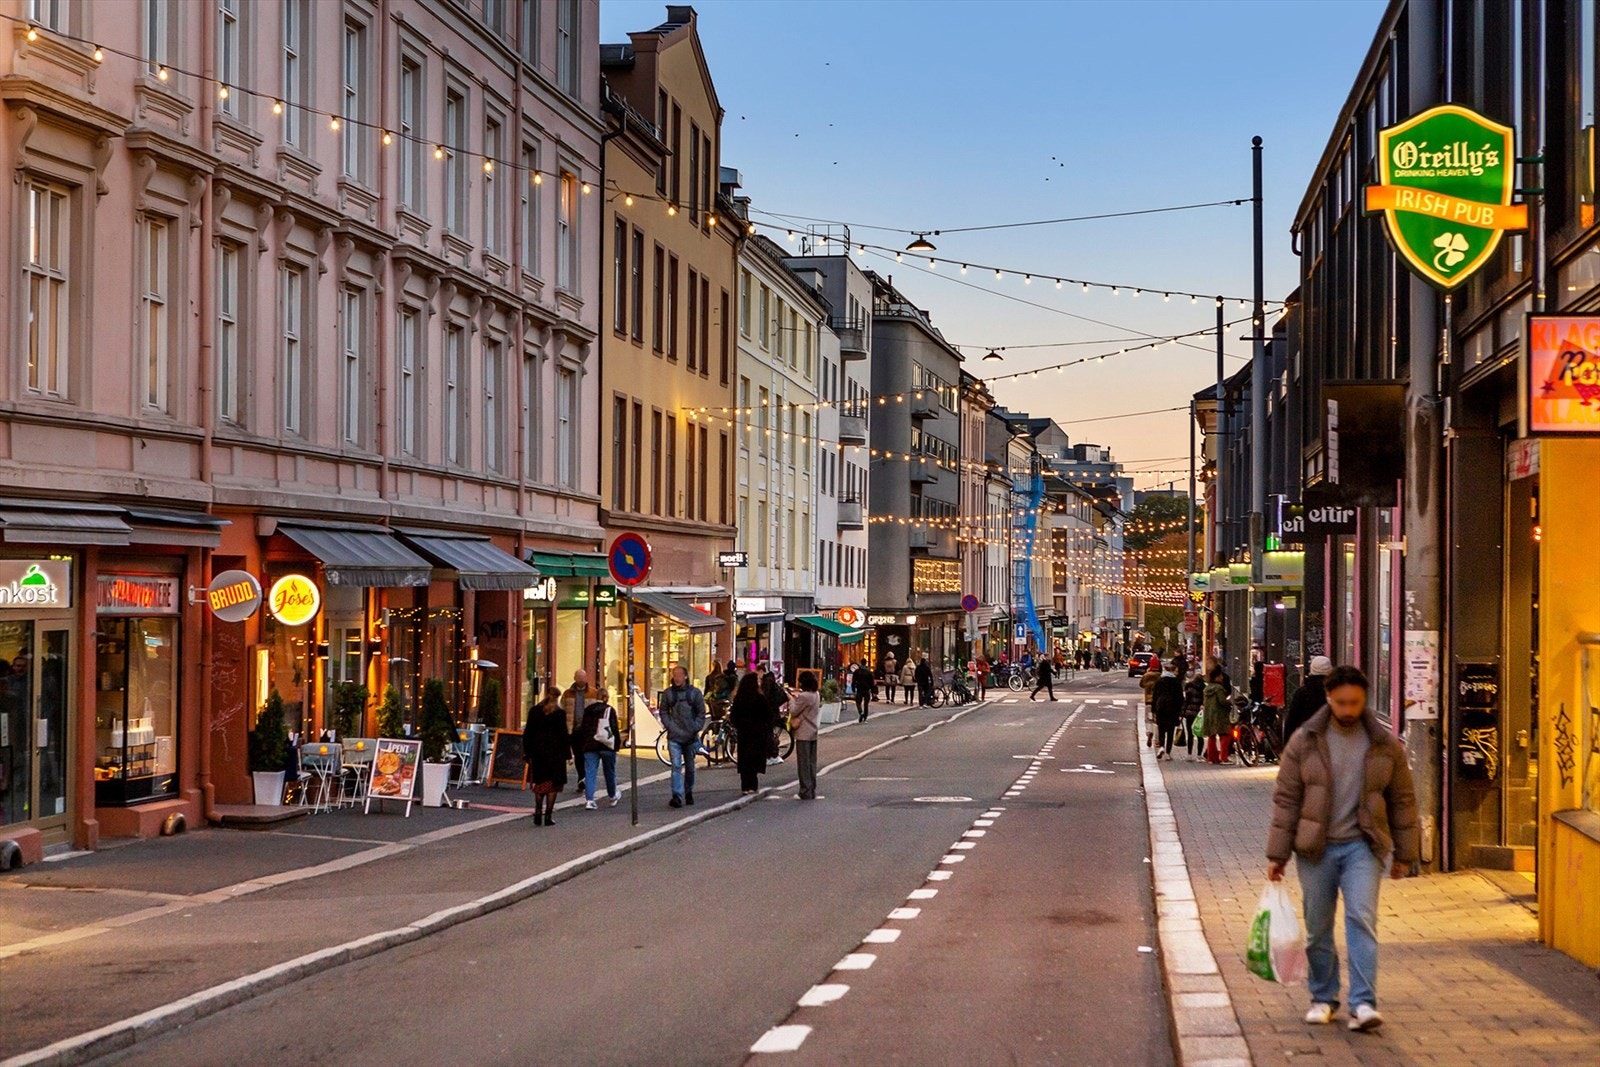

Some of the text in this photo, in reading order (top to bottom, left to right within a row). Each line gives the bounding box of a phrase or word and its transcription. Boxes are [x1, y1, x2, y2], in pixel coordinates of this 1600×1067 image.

[1393, 141, 1499, 176] O'reilly's
[1395, 190, 1494, 225] IRISH PUB
